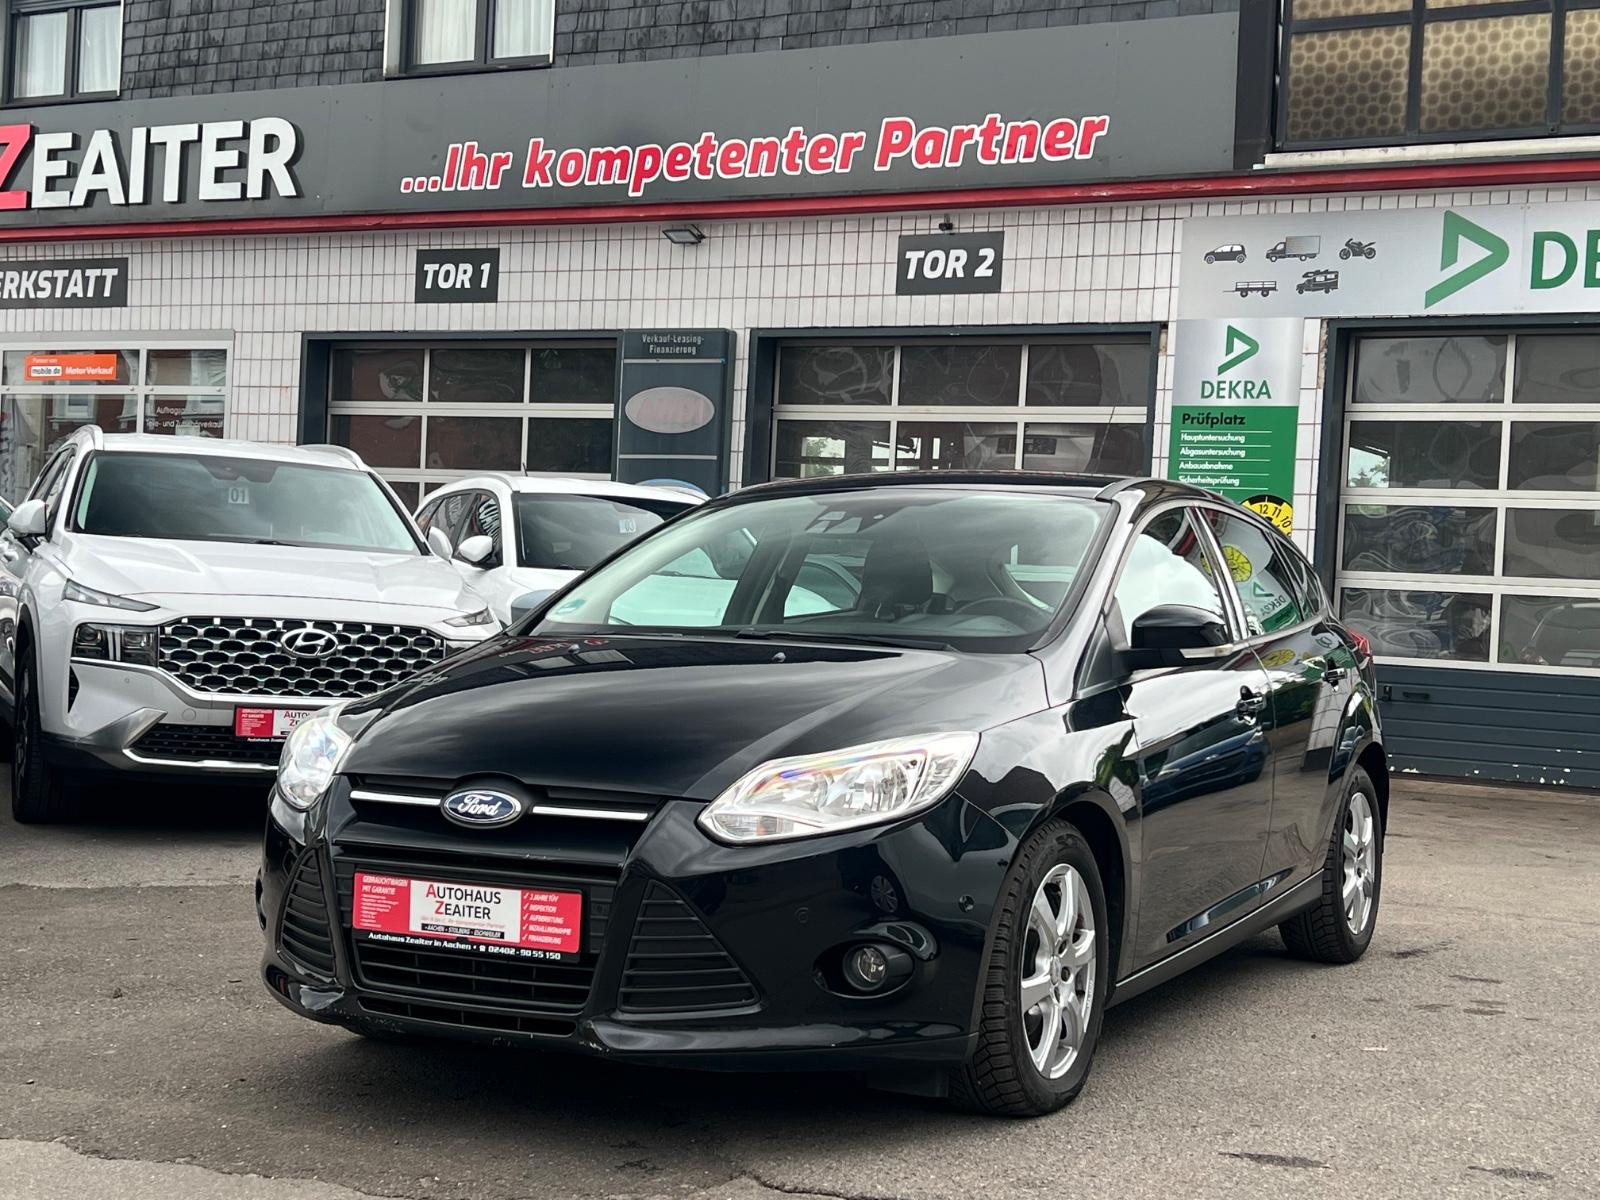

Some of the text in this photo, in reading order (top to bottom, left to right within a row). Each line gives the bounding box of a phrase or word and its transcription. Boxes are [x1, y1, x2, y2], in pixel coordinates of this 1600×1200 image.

[0, 117, 296, 208] ZEAITER
[522, 126, 866, 197] kompetenter
[874, 113, 1109, 171] Partner
[904, 247, 995, 280] TOR 2
[423, 262, 491, 289] TOR 1
[649, 345, 697, 355] Finanzierung
[1201, 380, 1272, 399] DEKRA
[1182, 412, 1246, 428] Prüfplatz
[1181, 433, 1245, 443] Hauptuntersuchung
[1180, 447, 1245, 457] Abgasuntersuchung
[1179, 461, 1233, 470] Anbauabnahme
[1179, 476, 1239, 486] Sicherheitsprüfung
[1260, 503, 1269, 515] 12
[1271, 506, 1281, 518] 11
[1280, 516, 1291, 528] 10
[457, 794, 502, 816] Ford
[426, 884, 501, 904] AUTOHAUS
[435, 900, 491, 919] ZEAITER
[368, 932, 405, 942] Autohaus
[406, 936, 432, 946] Zeaiter
[442, 941, 471, 950] Aachen
[488, 945, 515, 955] 02402
[545, 951, 561, 960] 150
